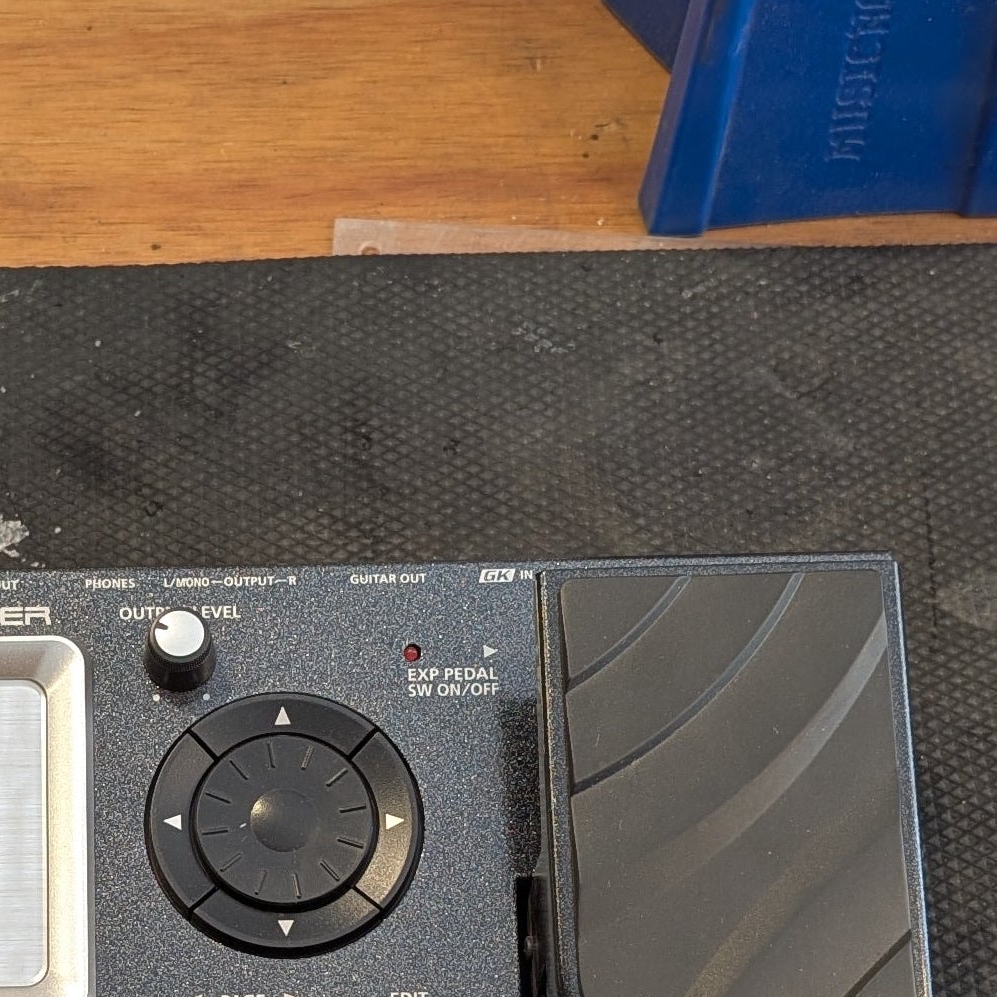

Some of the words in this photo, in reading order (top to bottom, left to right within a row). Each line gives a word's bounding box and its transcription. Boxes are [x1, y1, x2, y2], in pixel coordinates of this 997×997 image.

[164, 577, 209, 588] L/MONO
[223, 576, 274, 586] OUTPUT
[288, 575, 296, 586] R
[350, 574, 396, 584] GUITAR
[400, 573, 426, 583] OUT
[481, 570, 512, 581] GK
[520, 570, 533, 580] IN
[85, 578, 136, 589] PHONES
[196, 605, 241, 619] EVEL
[408, 668, 439, 682] EXP
[444, 667, 499, 681] PEDAL
[408, 683, 433, 697] SW
[437, 683, 499, 696] ON/OFF
